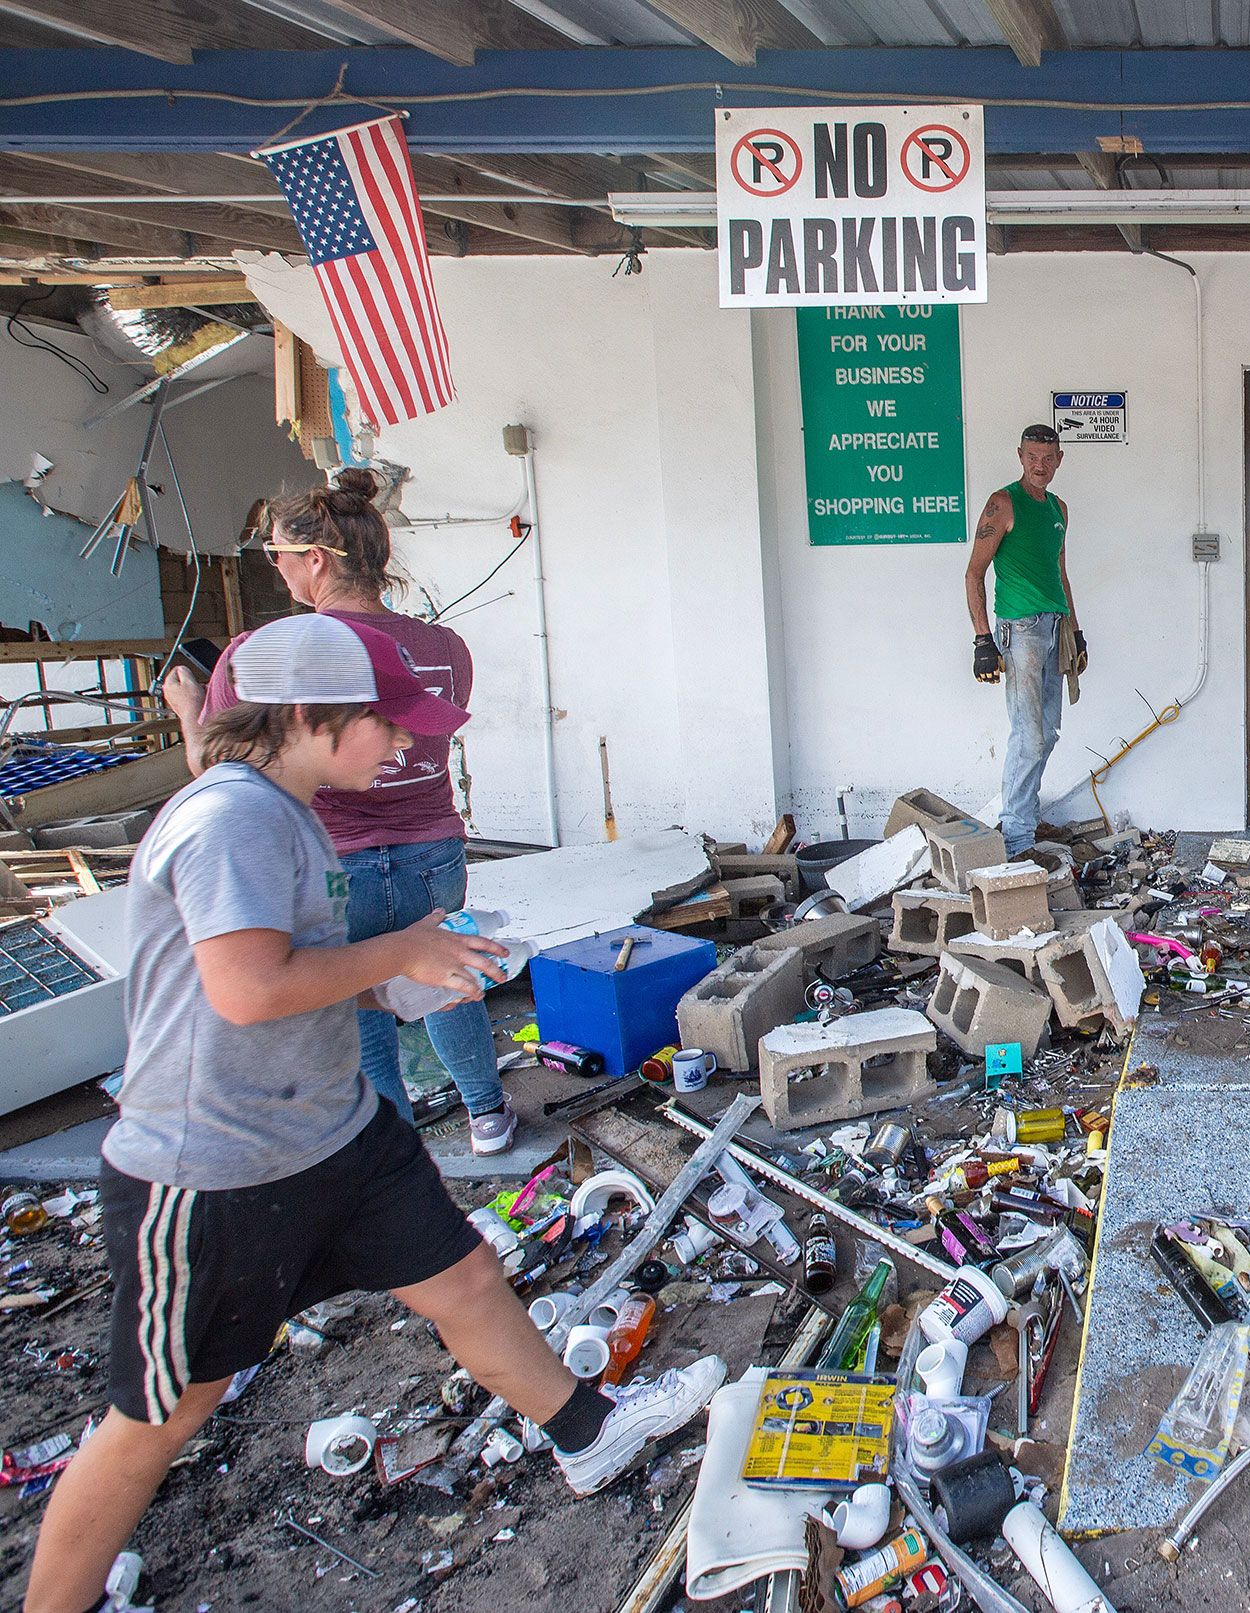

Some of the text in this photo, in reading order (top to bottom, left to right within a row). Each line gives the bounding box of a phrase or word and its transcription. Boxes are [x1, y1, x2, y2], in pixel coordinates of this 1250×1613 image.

[813, 121, 888, 199] NO
[729, 215, 976, 295] PARKING
[826, 304, 933, 319] THANK YOU
[830, 334, 927, 352] FOR YOUR
[835, 366, 925, 385] BUSINESS
[866, 400, 896, 417] WE
[1070, 395, 1109, 406] NOTICE
[1089, 416, 1120, 424] 24 HOUR
[1094, 424, 1115, 432] VIDEO
[829, 432, 939, 451] APPRECIATE
[867, 465, 903, 482] YOU
[814, 496, 960, 516] SHOPPING HERE
[816, 1374, 848, 1382] IRWIN
